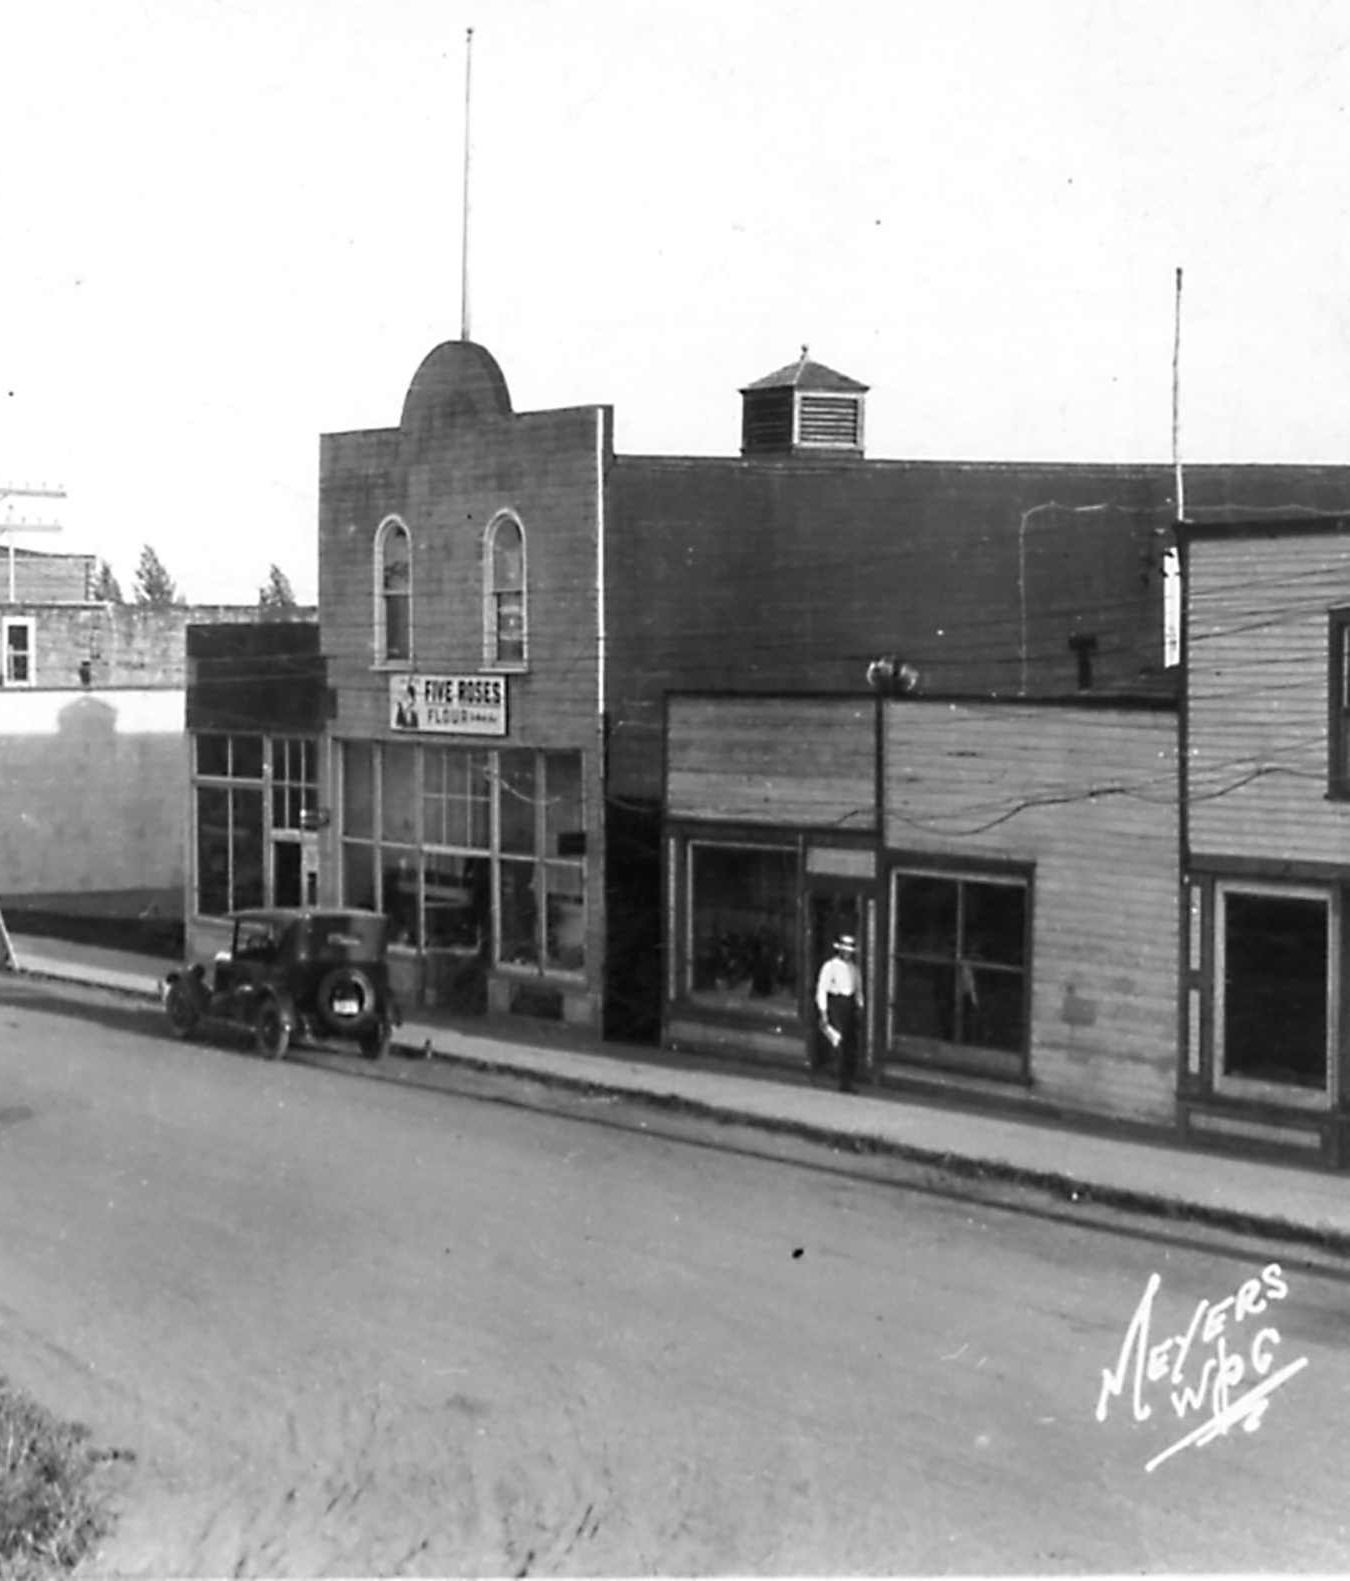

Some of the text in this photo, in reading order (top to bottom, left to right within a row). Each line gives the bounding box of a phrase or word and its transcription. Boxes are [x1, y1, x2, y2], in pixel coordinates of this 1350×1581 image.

[425, 680, 501, 704] FIVE ROSES
[428, 708, 468, 724] FLOUR
